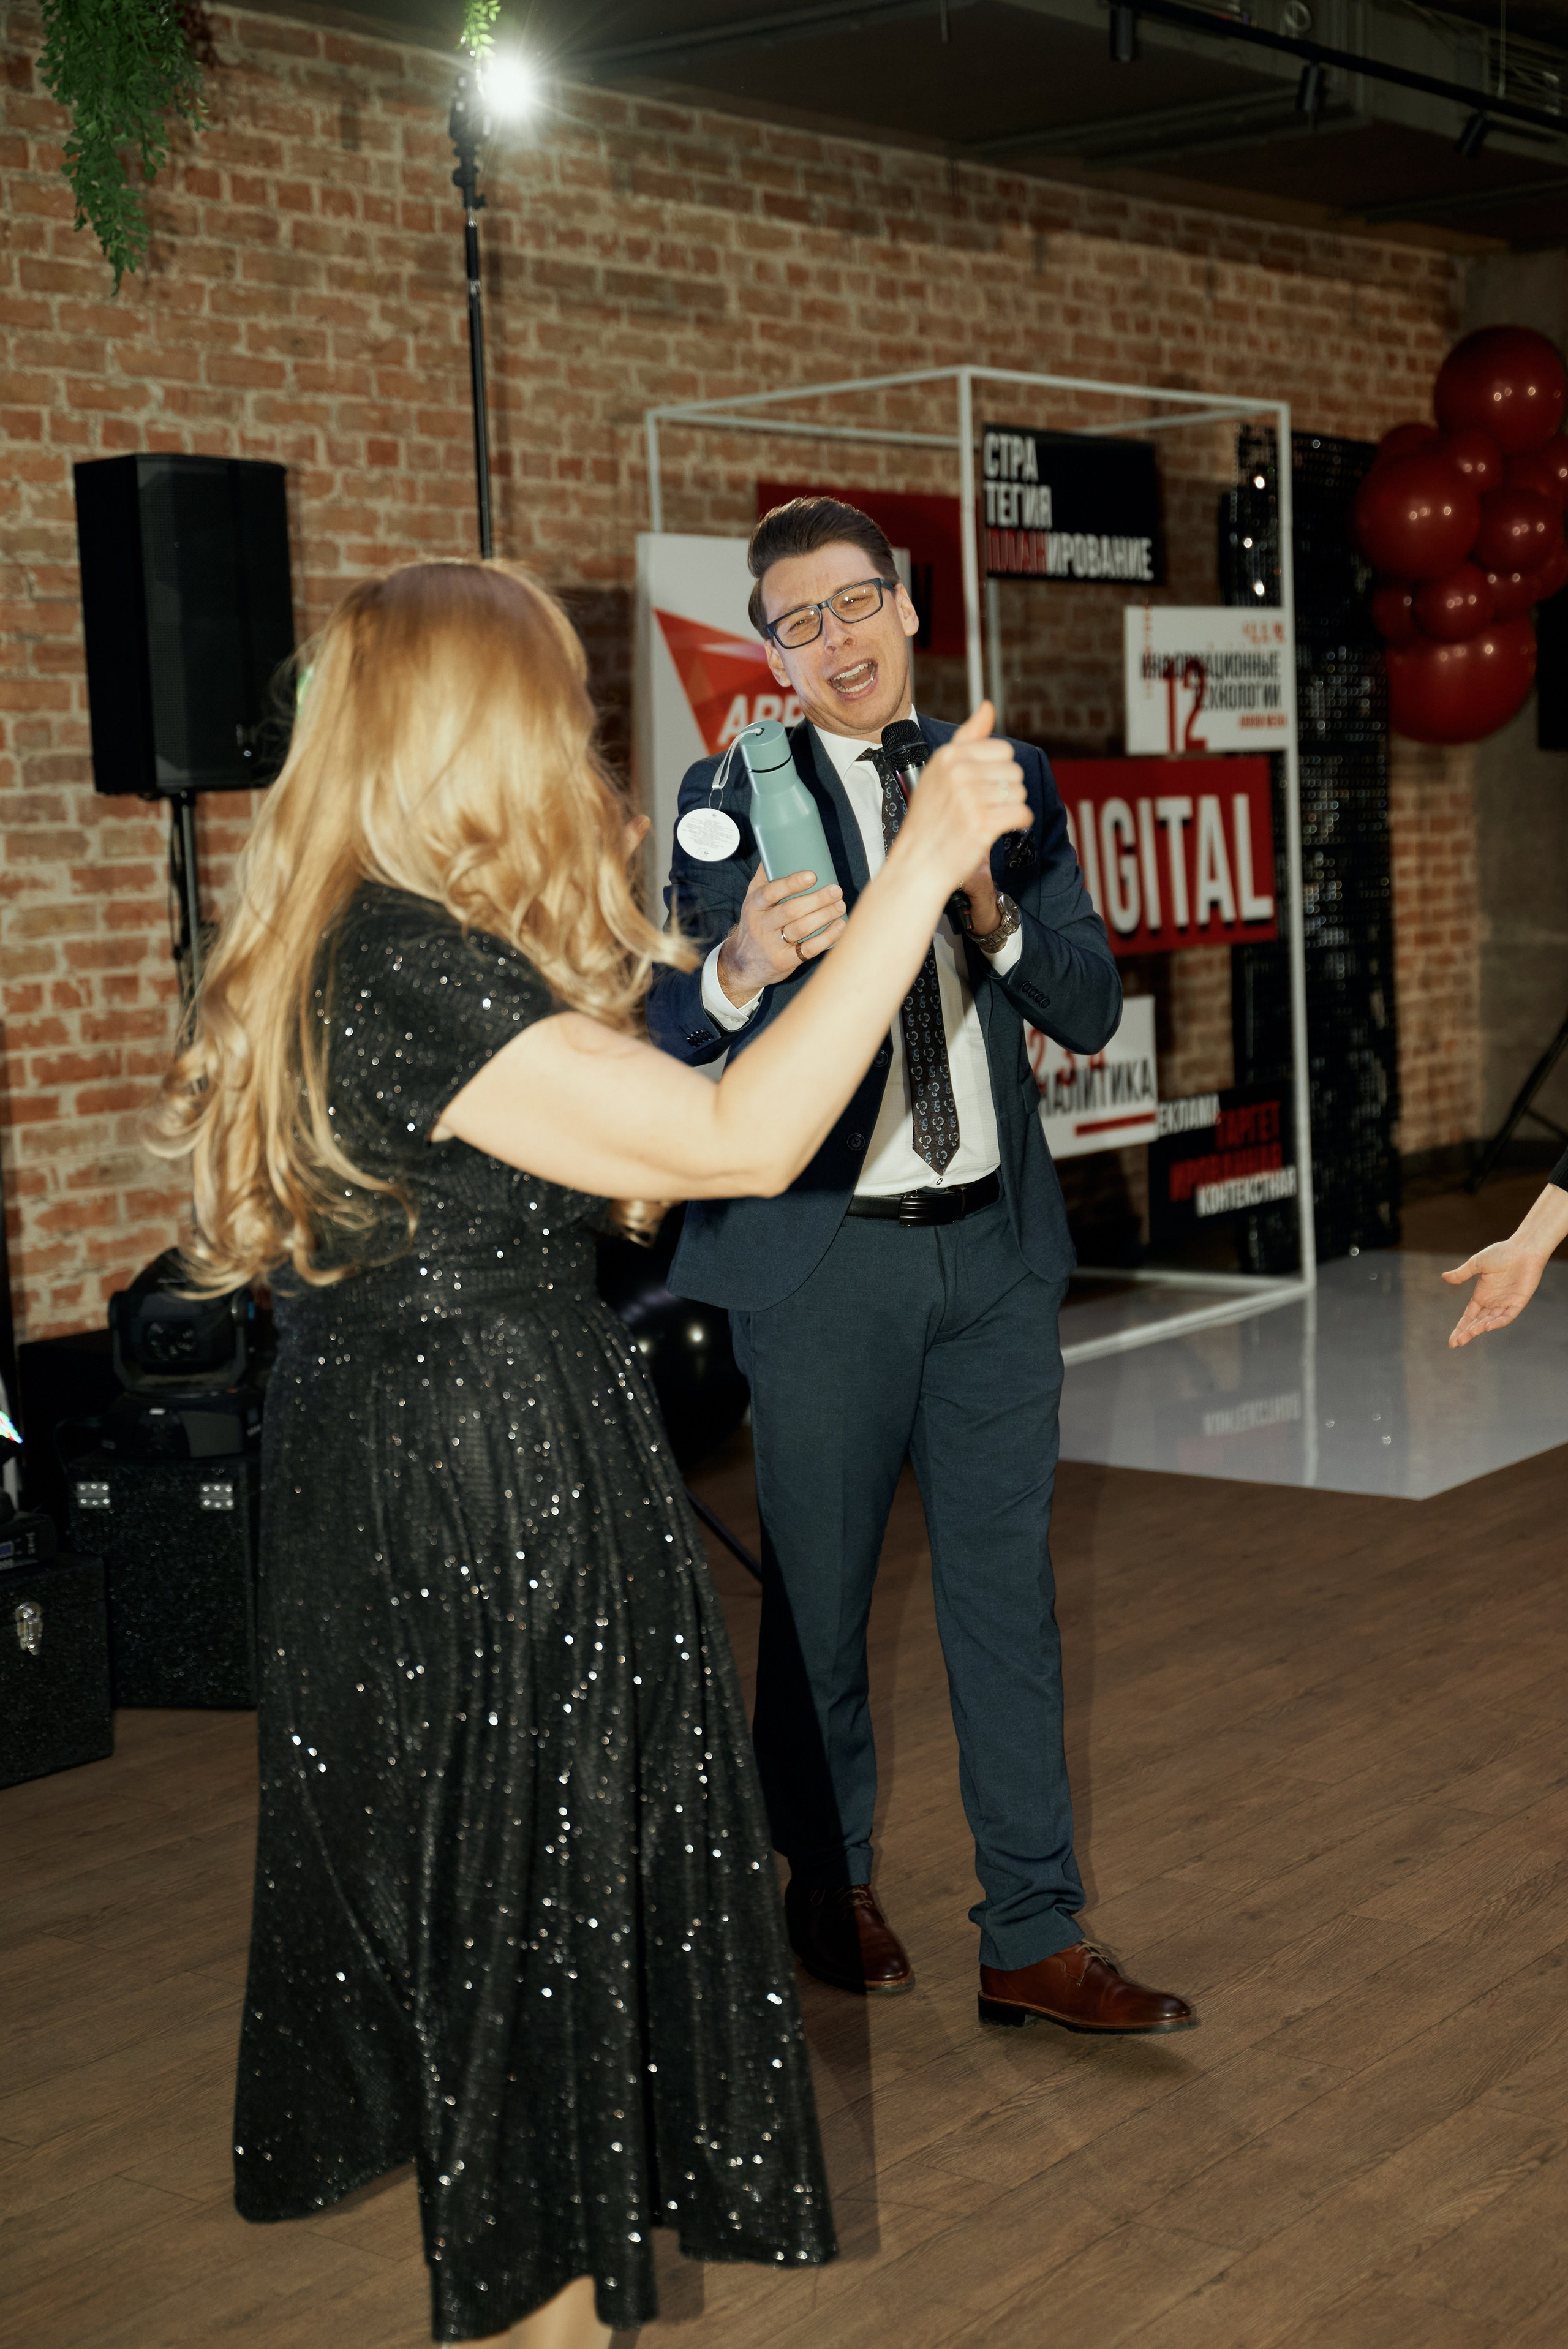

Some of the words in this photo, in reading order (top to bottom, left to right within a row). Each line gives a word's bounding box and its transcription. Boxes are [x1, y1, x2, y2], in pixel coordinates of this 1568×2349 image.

[984, 432, 1038, 482] СТРА
[984, 481, 1052, 530] ТЕГИЯ
[986, 528, 1154, 581] ПЛАНИРОВАНИЕ
[1192, 682, 1281, 709] ХНОЛОГИИ
[1067, 794, 1275, 935] IGITAL
[1041, 1058, 1155, 1118] НАЛИТИКА
[1159, 1093, 1221, 1136] ЕКЛАМА
[1196, 1166, 1297, 1218] КОНТЕКСТНАЯ
